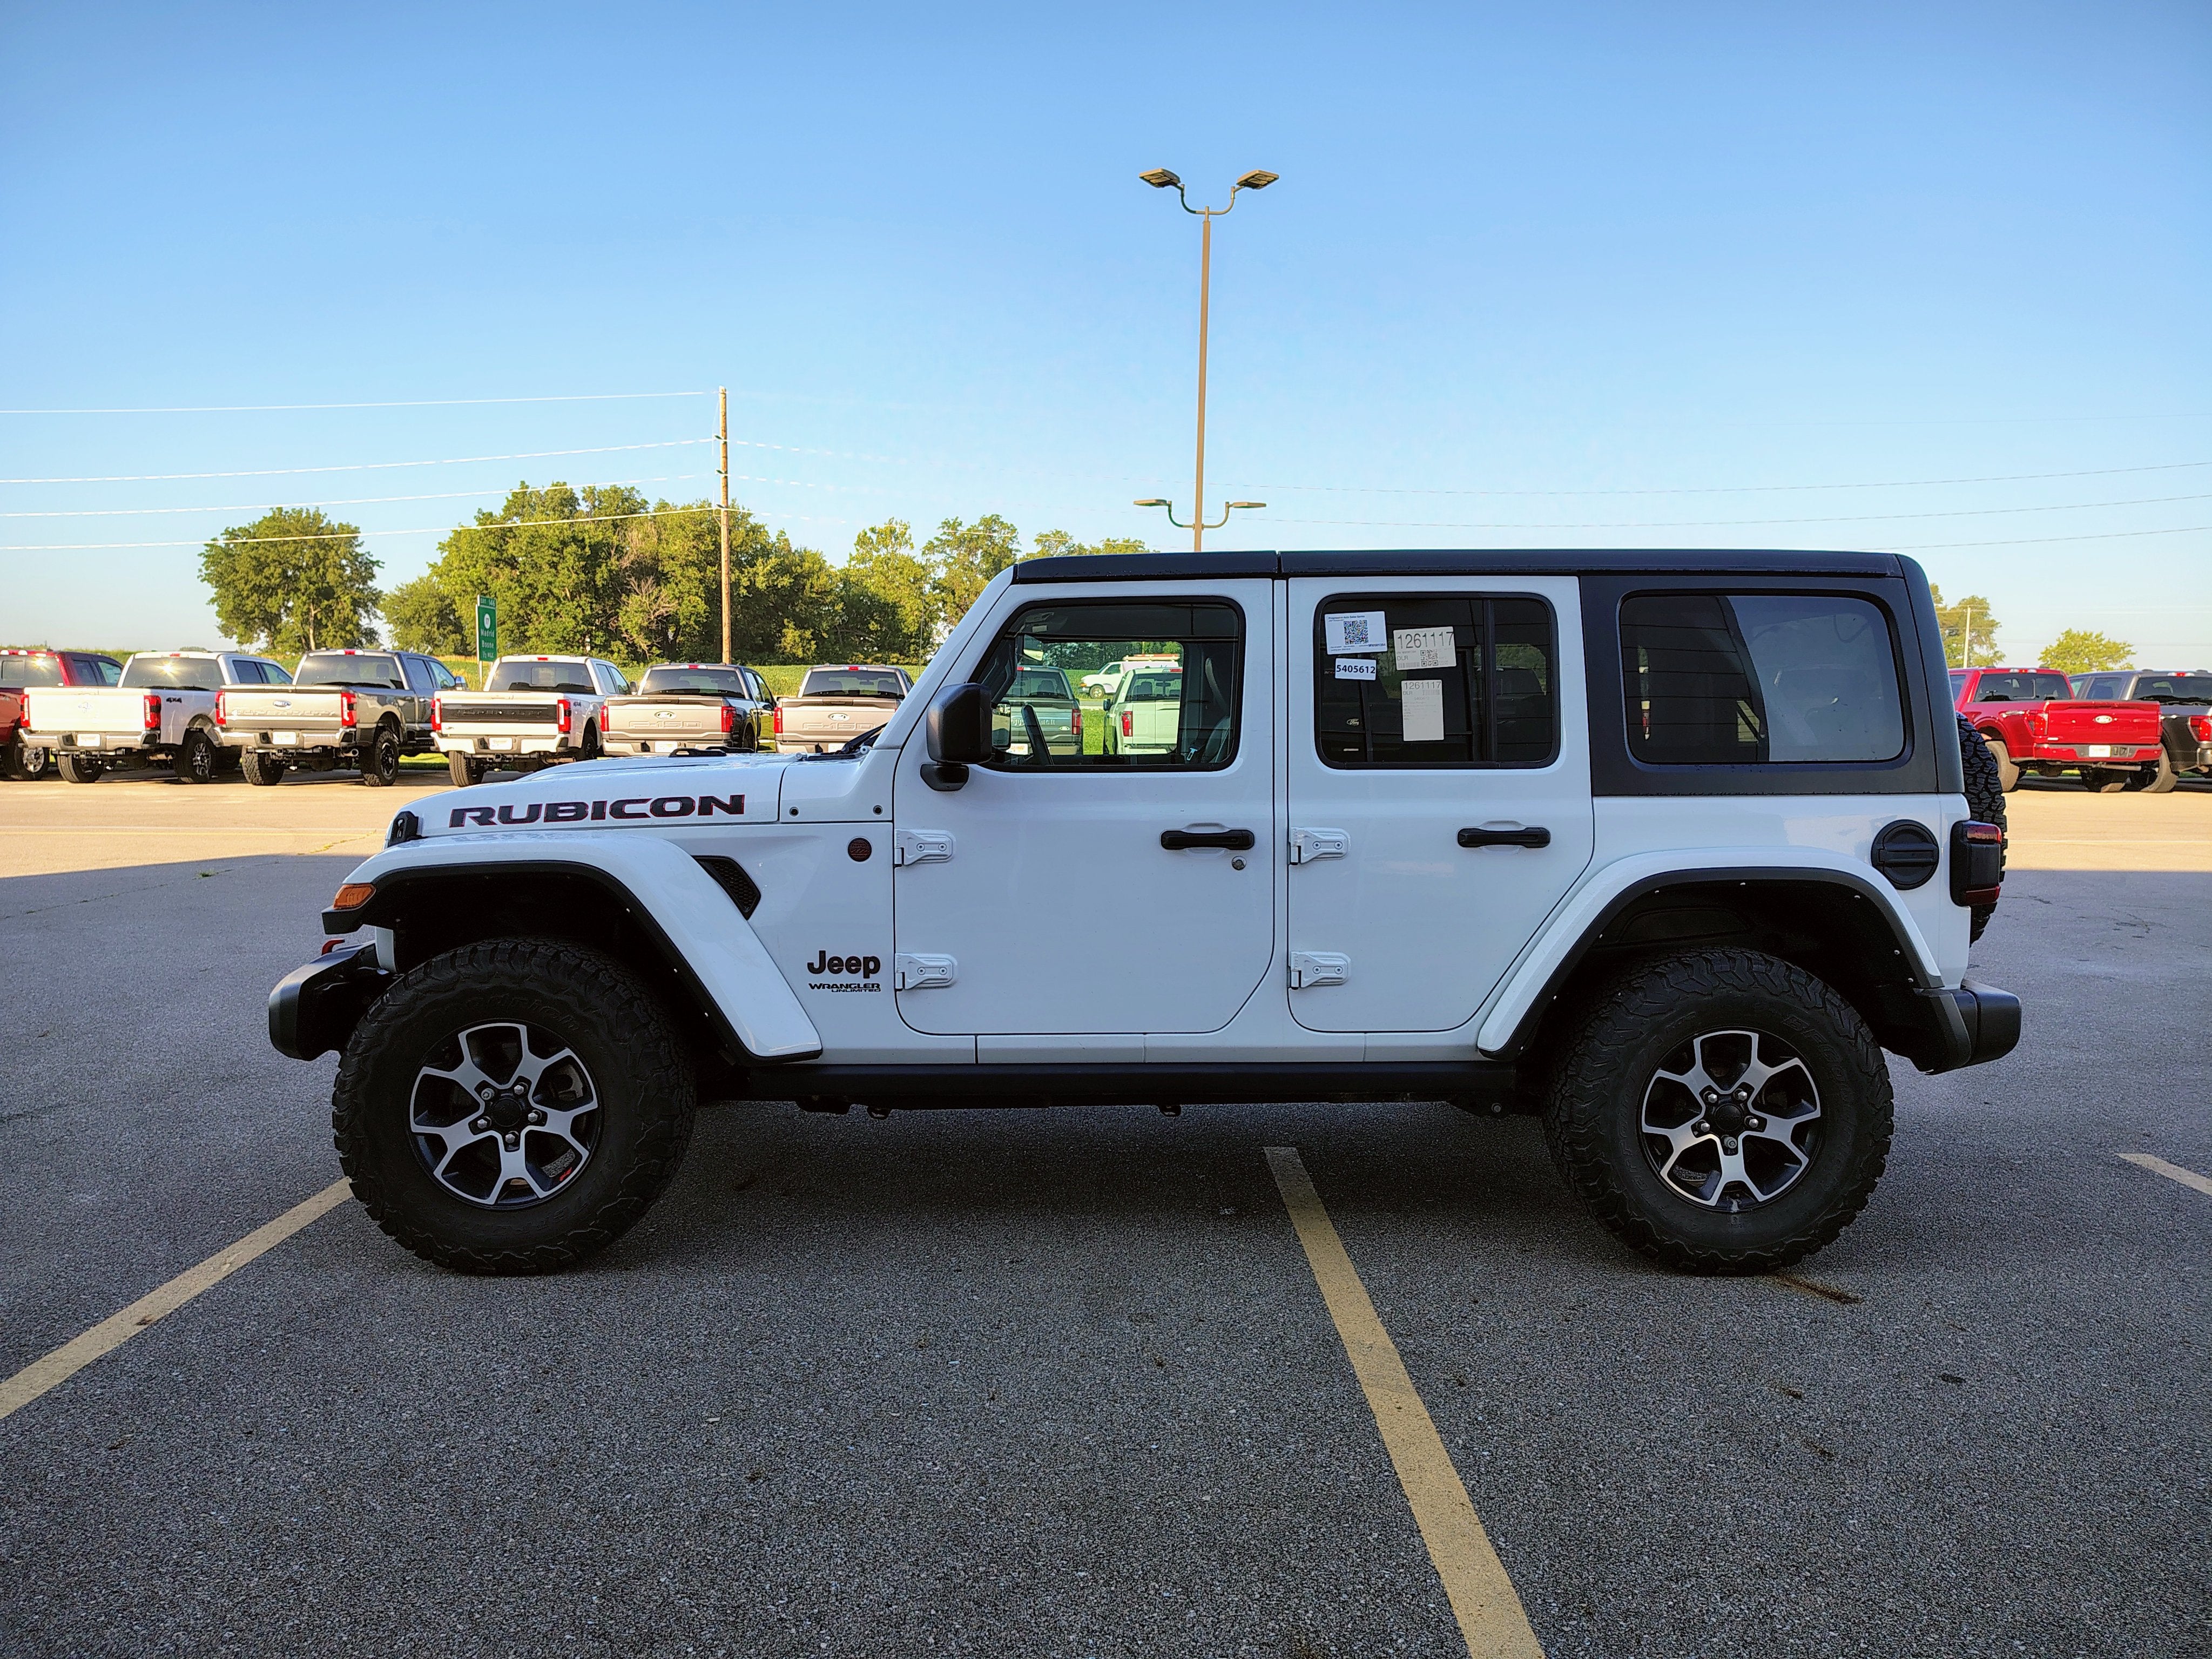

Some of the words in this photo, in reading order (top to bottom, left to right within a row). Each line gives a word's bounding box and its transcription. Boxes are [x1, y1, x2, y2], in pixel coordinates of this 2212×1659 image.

[480, 629, 495, 637] Madrid
[481, 639, 494, 649] Boone
[1398, 631, 1454, 649] 1261117
[1336, 665, 1375, 674] 5405612
[1404, 681, 1441, 690] 1261117
[628, 720, 702, 729] F-150
[802, 722, 875, 730] F-150
[449, 794, 745, 828] RUBICON
[807, 950, 881, 979] Jeep
